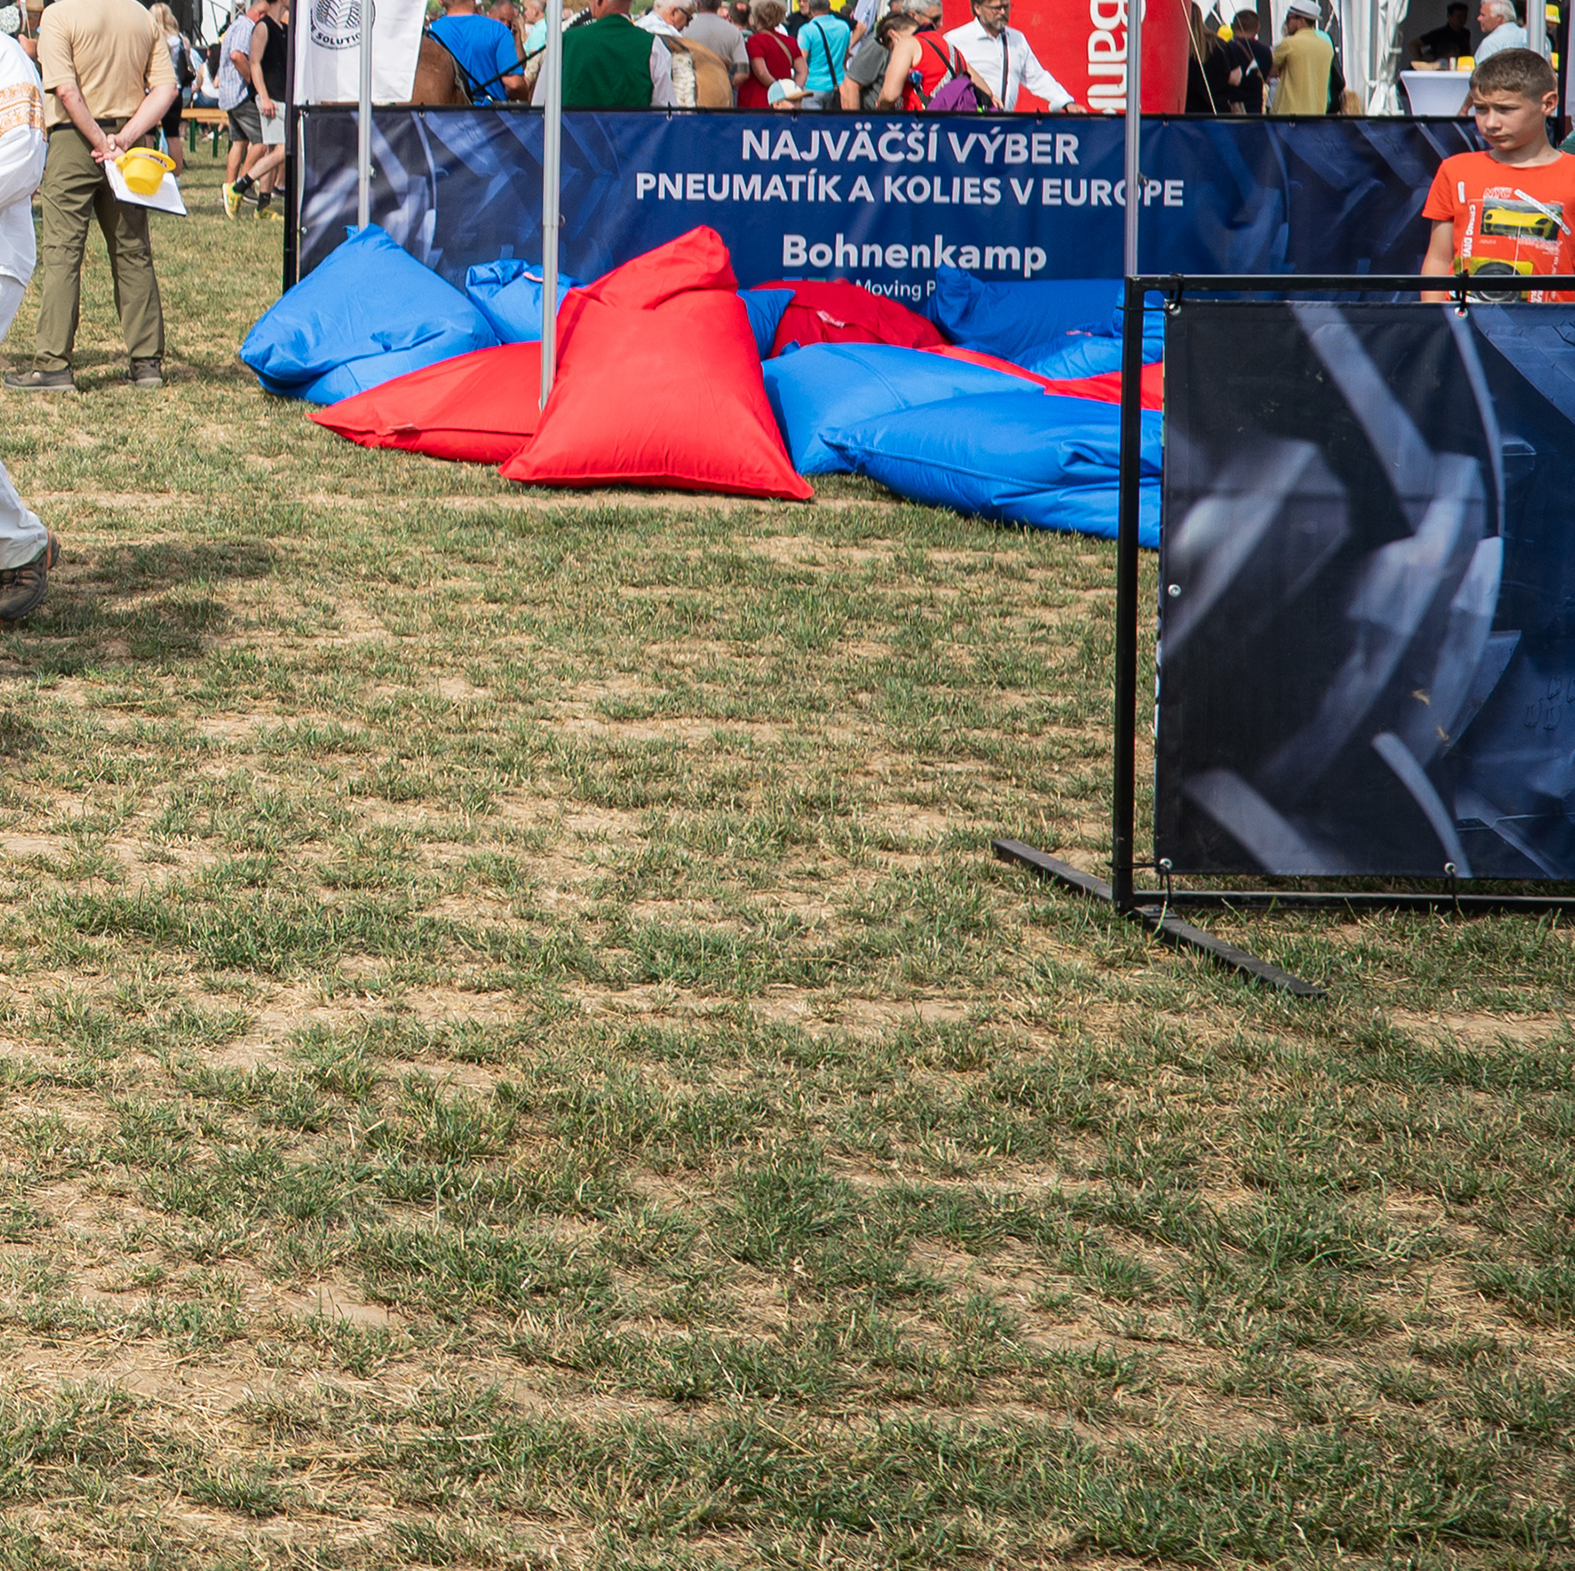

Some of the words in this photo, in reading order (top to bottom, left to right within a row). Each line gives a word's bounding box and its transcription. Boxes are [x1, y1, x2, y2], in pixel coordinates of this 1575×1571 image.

[741, 122, 938, 163] NAJVÄČŠÍ
[947, 127, 1080, 166] VÝBER
[635, 170, 842, 204] PNEUMATÍK
[847, 175, 874, 203] A
[884, 174, 1001, 206] KOLIES
[1009, 177, 1035, 206] V
[782, 234, 1048, 278] Bohnenkamp
[854, 279, 922, 302] Moving
